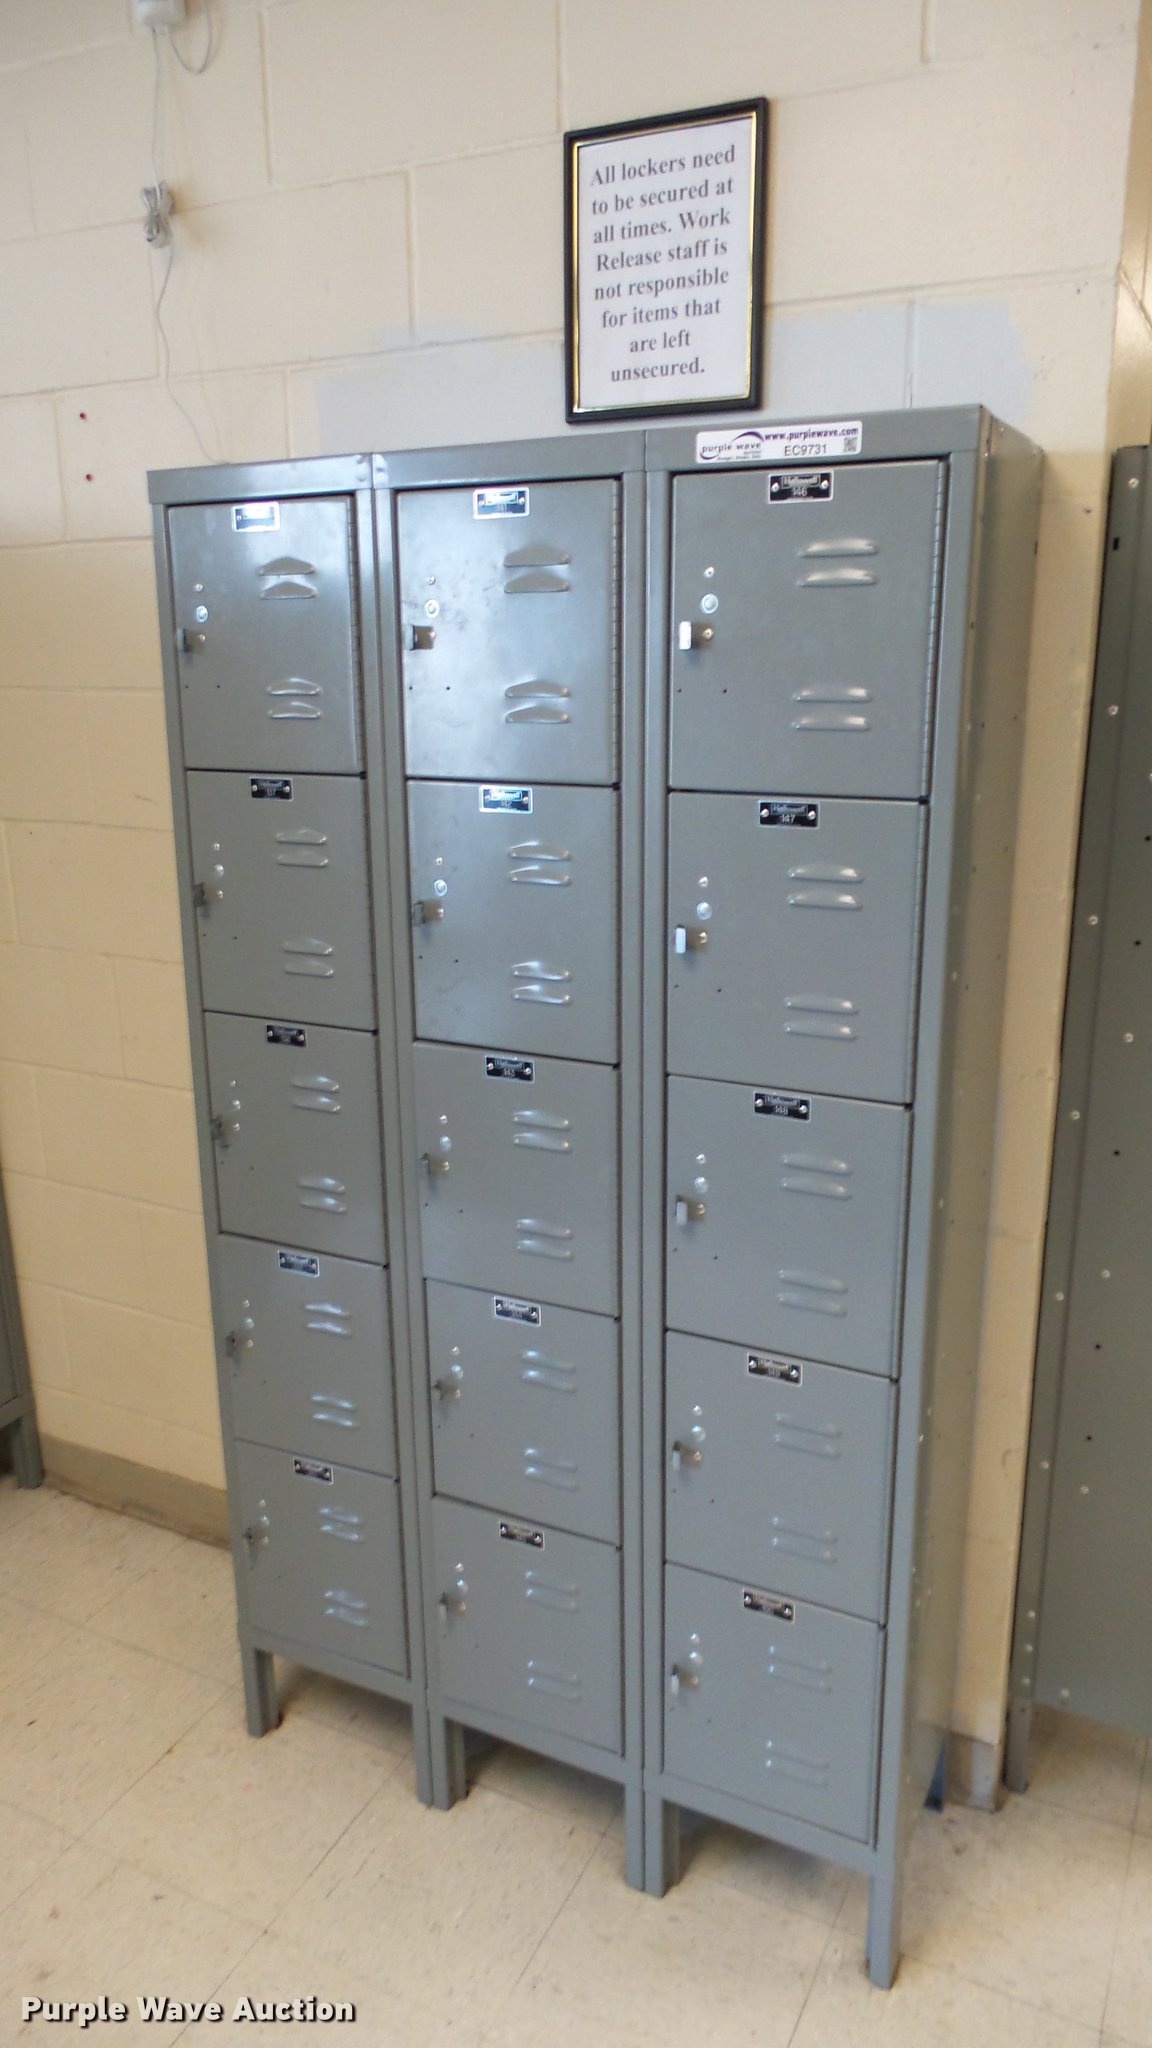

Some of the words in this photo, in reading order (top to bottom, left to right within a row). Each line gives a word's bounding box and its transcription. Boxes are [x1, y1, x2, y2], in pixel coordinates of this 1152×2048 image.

[591, 165, 615, 186] All
[622, 157, 686, 180] lockers
[693, 145, 735, 167] need
[592, 200, 608, 215] to
[615, 193, 633, 212] be
[640, 179, 709, 207] secured
[716, 177, 734, 195] at
[593, 224, 615, 244] all
[620, 218, 672, 240] times.
[679, 207, 731, 230] Work
[596, 247, 662, 272] Release
[667, 239, 712, 262] staff
[714, 238, 728, 256] is
[594, 282, 622, 301] not
[628, 267, 729, 298] responsible
[601, 309, 628, 328] for
[632, 304, 679, 325] items
[685, 298, 721, 318] that
[629, 336, 657, 353] are
[663, 329, 691, 349] left
[611, 356, 705, 382] unsecured.
[702, 443, 733, 453] purple
[764, 427, 859, 441] www.purplewave.com
[784, 444, 827, 457] EC9731
